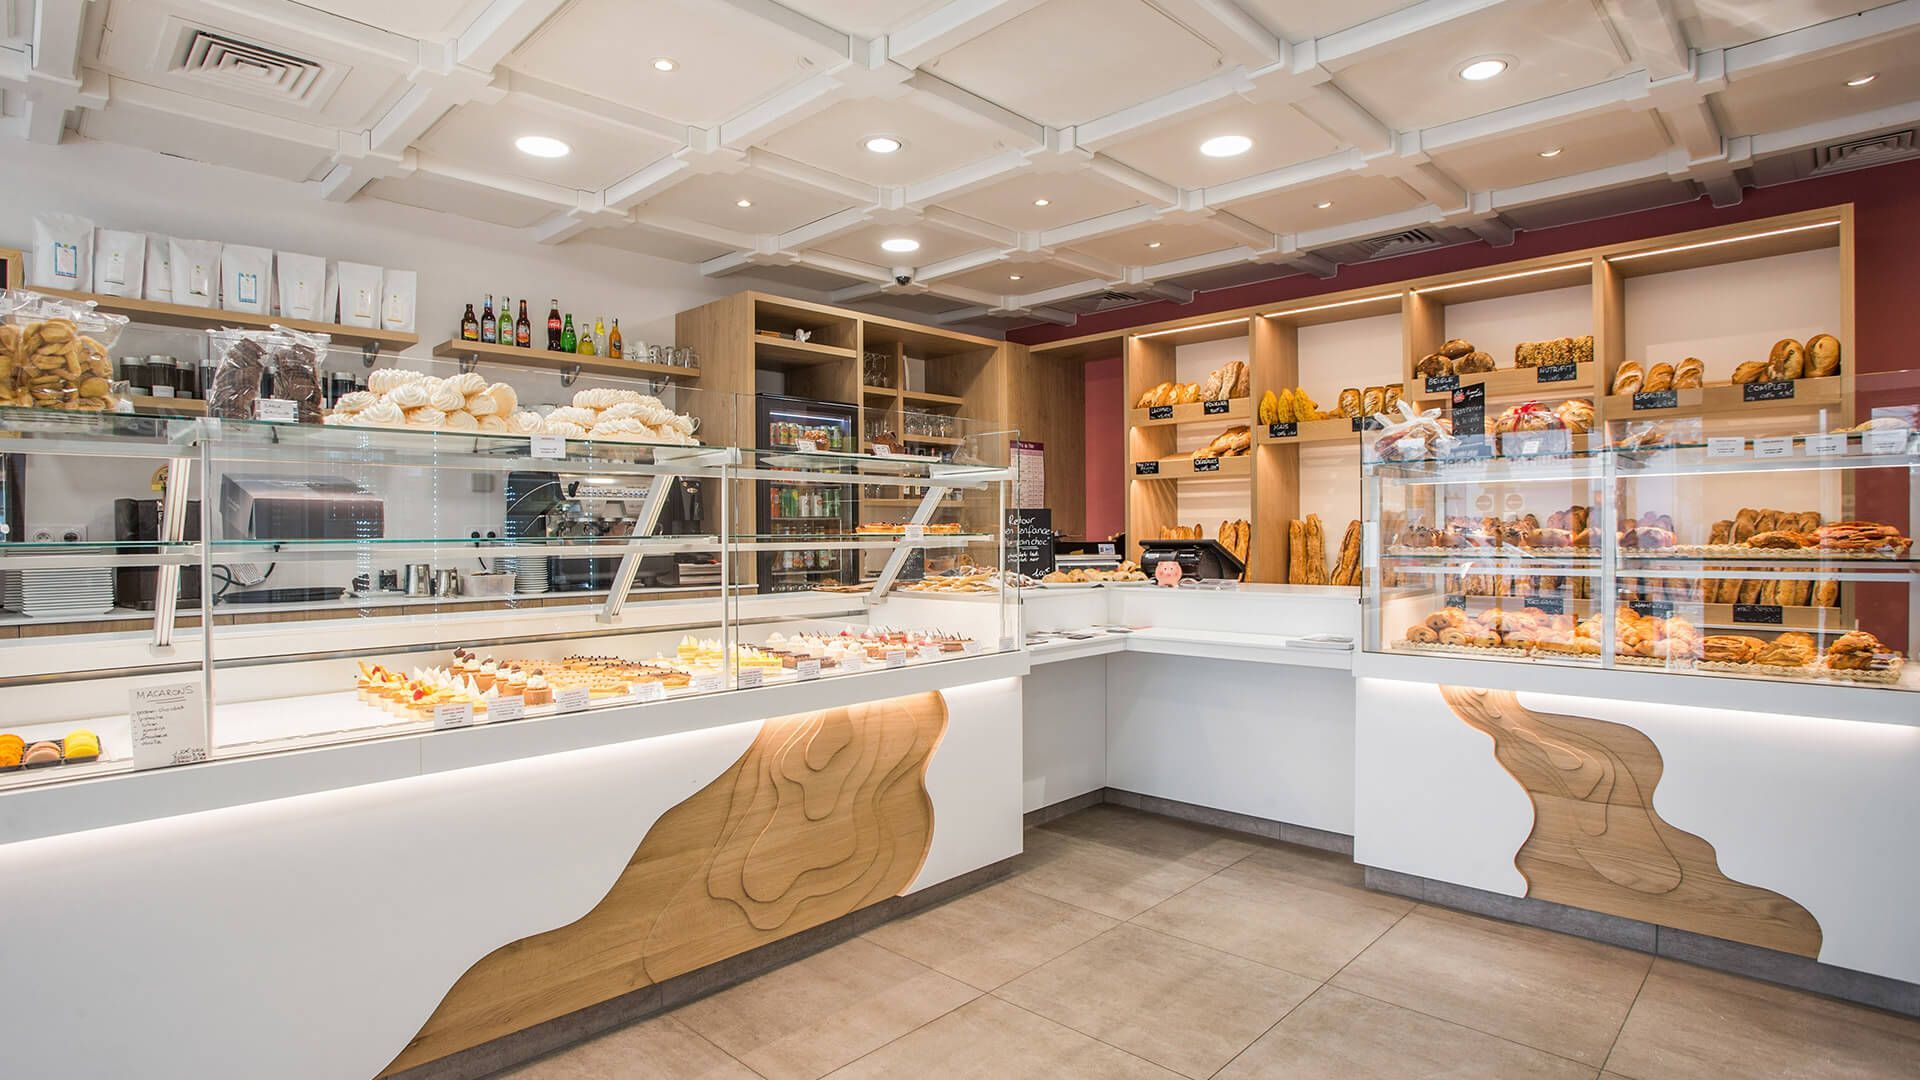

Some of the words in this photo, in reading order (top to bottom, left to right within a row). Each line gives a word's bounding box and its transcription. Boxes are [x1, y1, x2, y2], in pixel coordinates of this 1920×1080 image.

[1747, 382, 1791, 393] COMPLET
[1008, 514, 1036, 526] Retour
[136, 685, 194, 699] MACARONS
